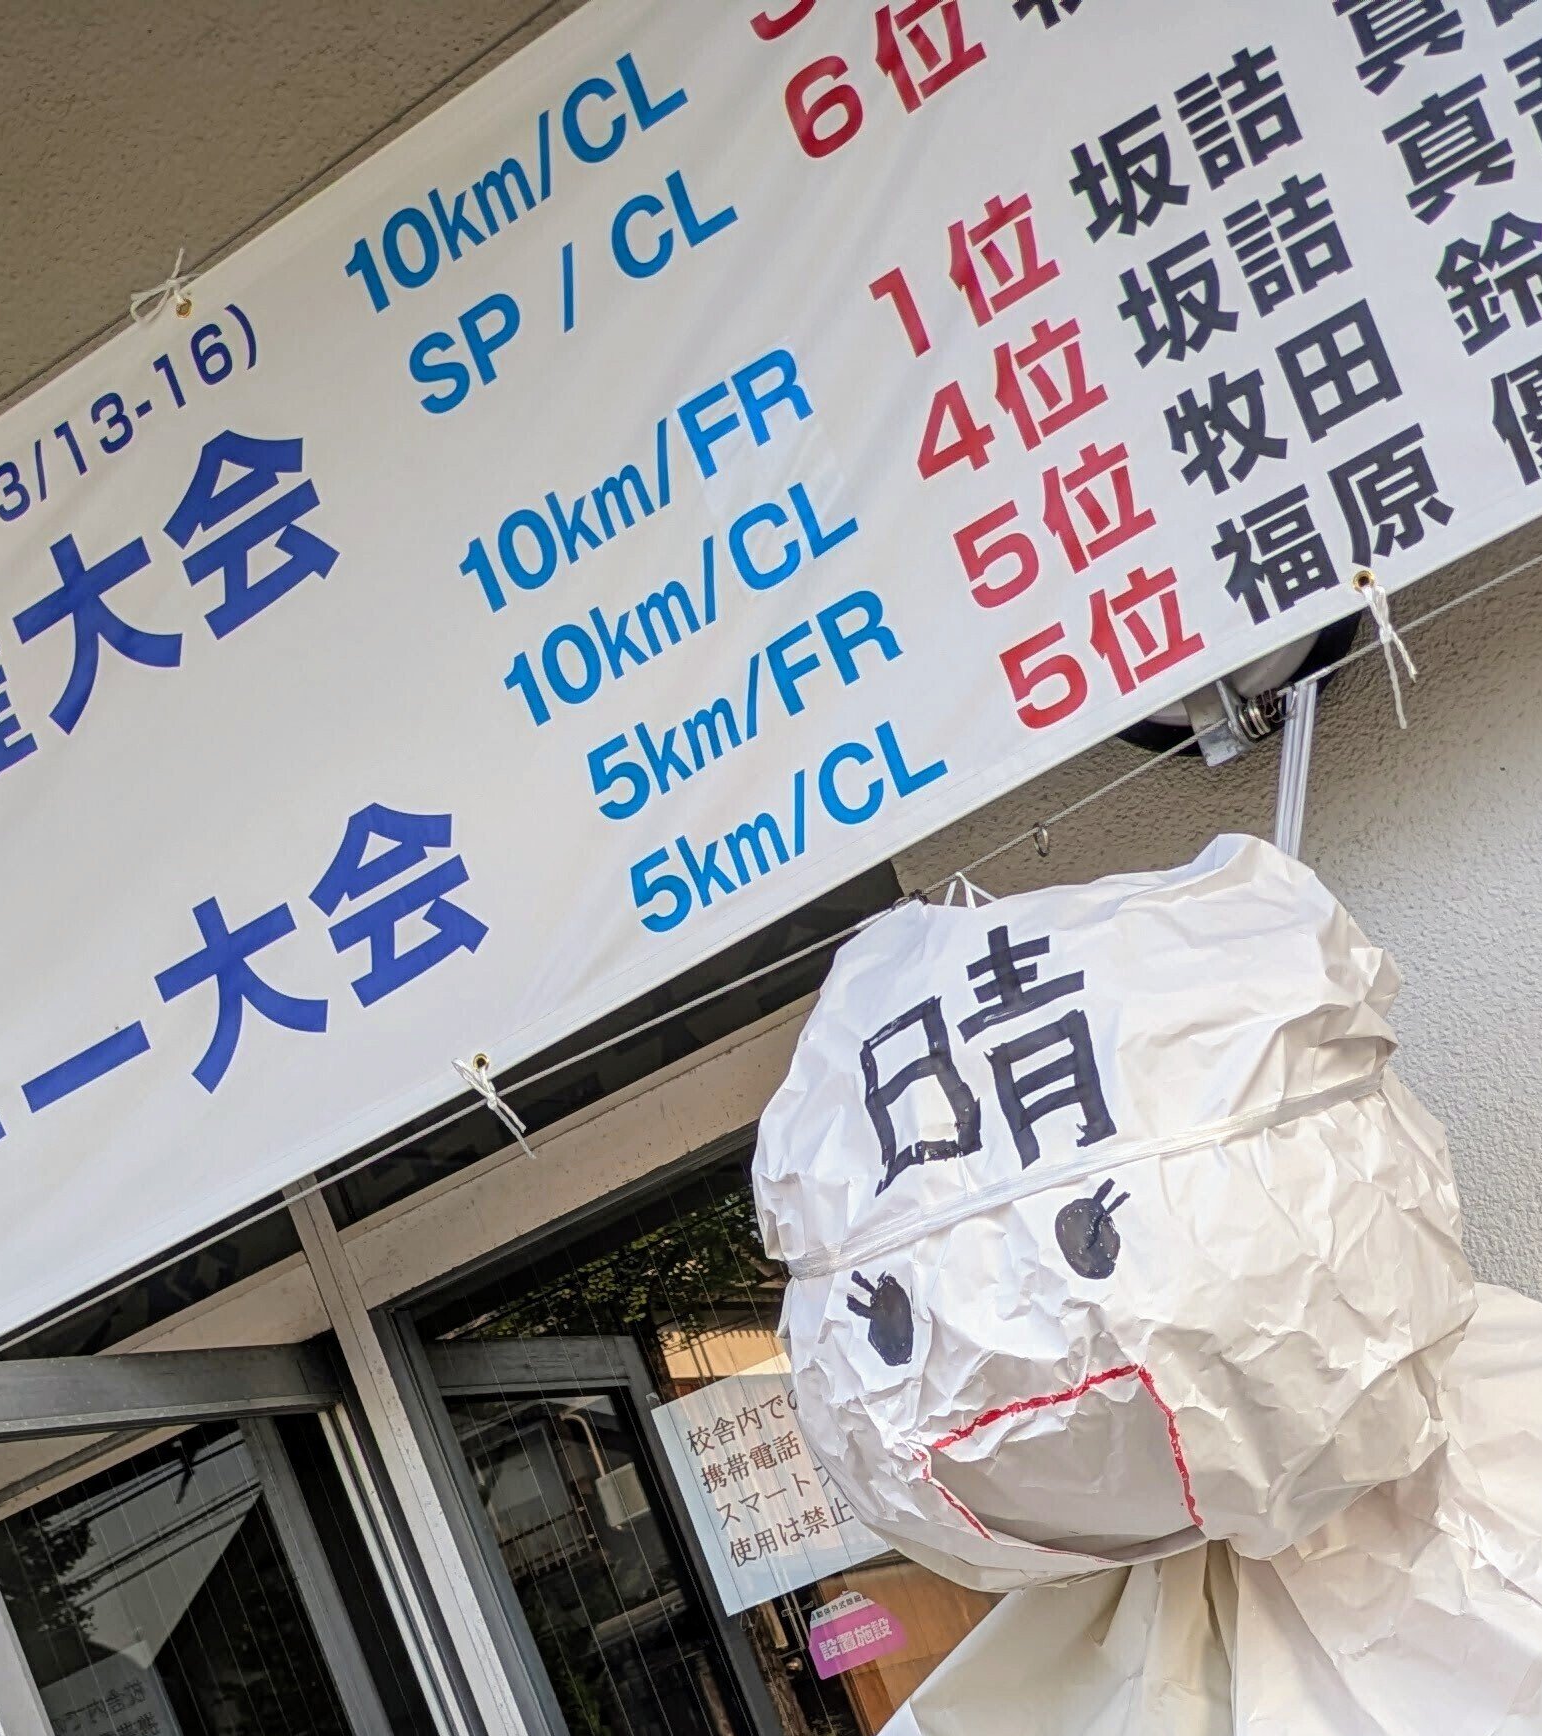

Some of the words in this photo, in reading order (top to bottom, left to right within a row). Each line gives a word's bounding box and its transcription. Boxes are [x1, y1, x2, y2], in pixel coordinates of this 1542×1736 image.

[344, 52, 688, 314] 10km/CL
[409, 292, 520, 414] SP
[610, 169, 738, 279] CL
[784, 0, 987, 158] 6位
[459, 349, 813, 613] 10km/FR
[869, 193, 1060, 357] 1位
[1069, 47, 1304, 247] 坂詰
[503, 482, 859, 728] 10km/CL
[917, 318, 1109, 482] 4位
[1117, 171, 1356, 369] 坂詰
[587, 589, 904, 820] 5km/FR
[952, 442, 1156, 609] 5位
[1162, 298, 1403, 496] 牧田
[630, 721, 947, 934] 5km/CL
[998, 567, 1205, 729] 5位
[1211, 423, 1456, 627] 福原
[859, 924, 1117, 1197] 晴
[700, 1431, 801, 1495] 携帯電話
[729, 1498, 854, 1568] 使用は禁止
